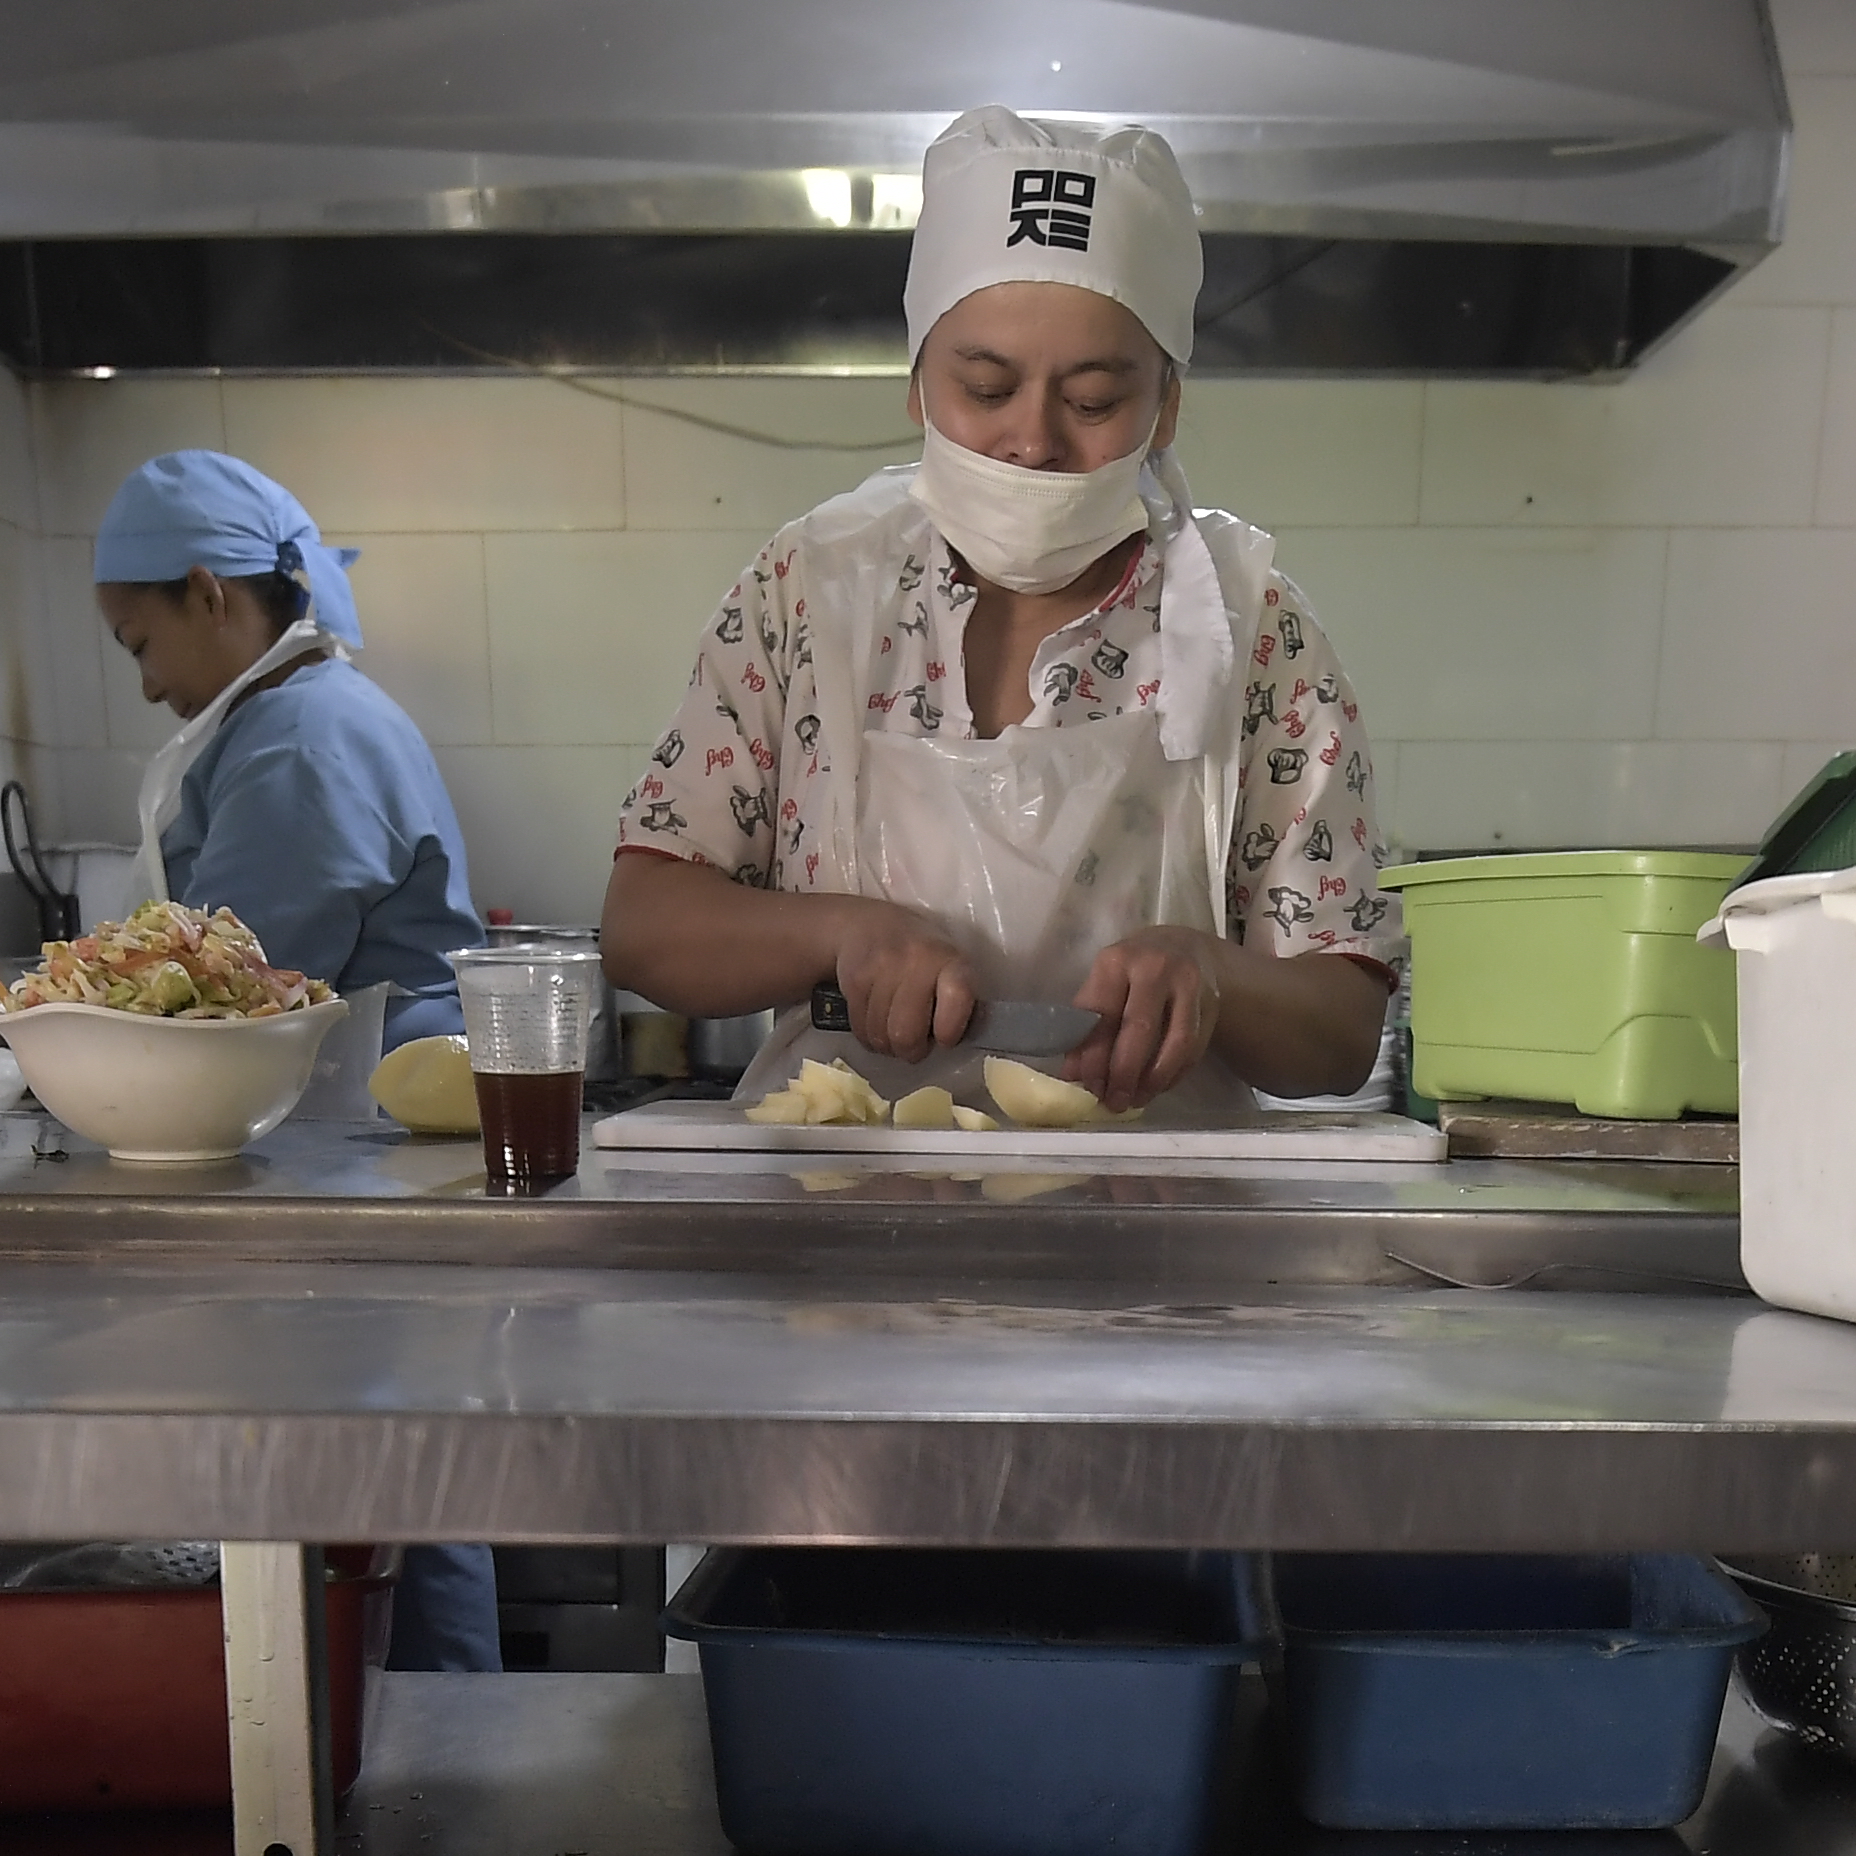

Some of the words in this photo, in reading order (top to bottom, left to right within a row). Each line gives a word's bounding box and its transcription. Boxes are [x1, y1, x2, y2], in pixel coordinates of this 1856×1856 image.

[868, 690, 901, 713] Chef
[705, 747, 735, 776] Chef
[1317, 875, 1347, 901] Chef
